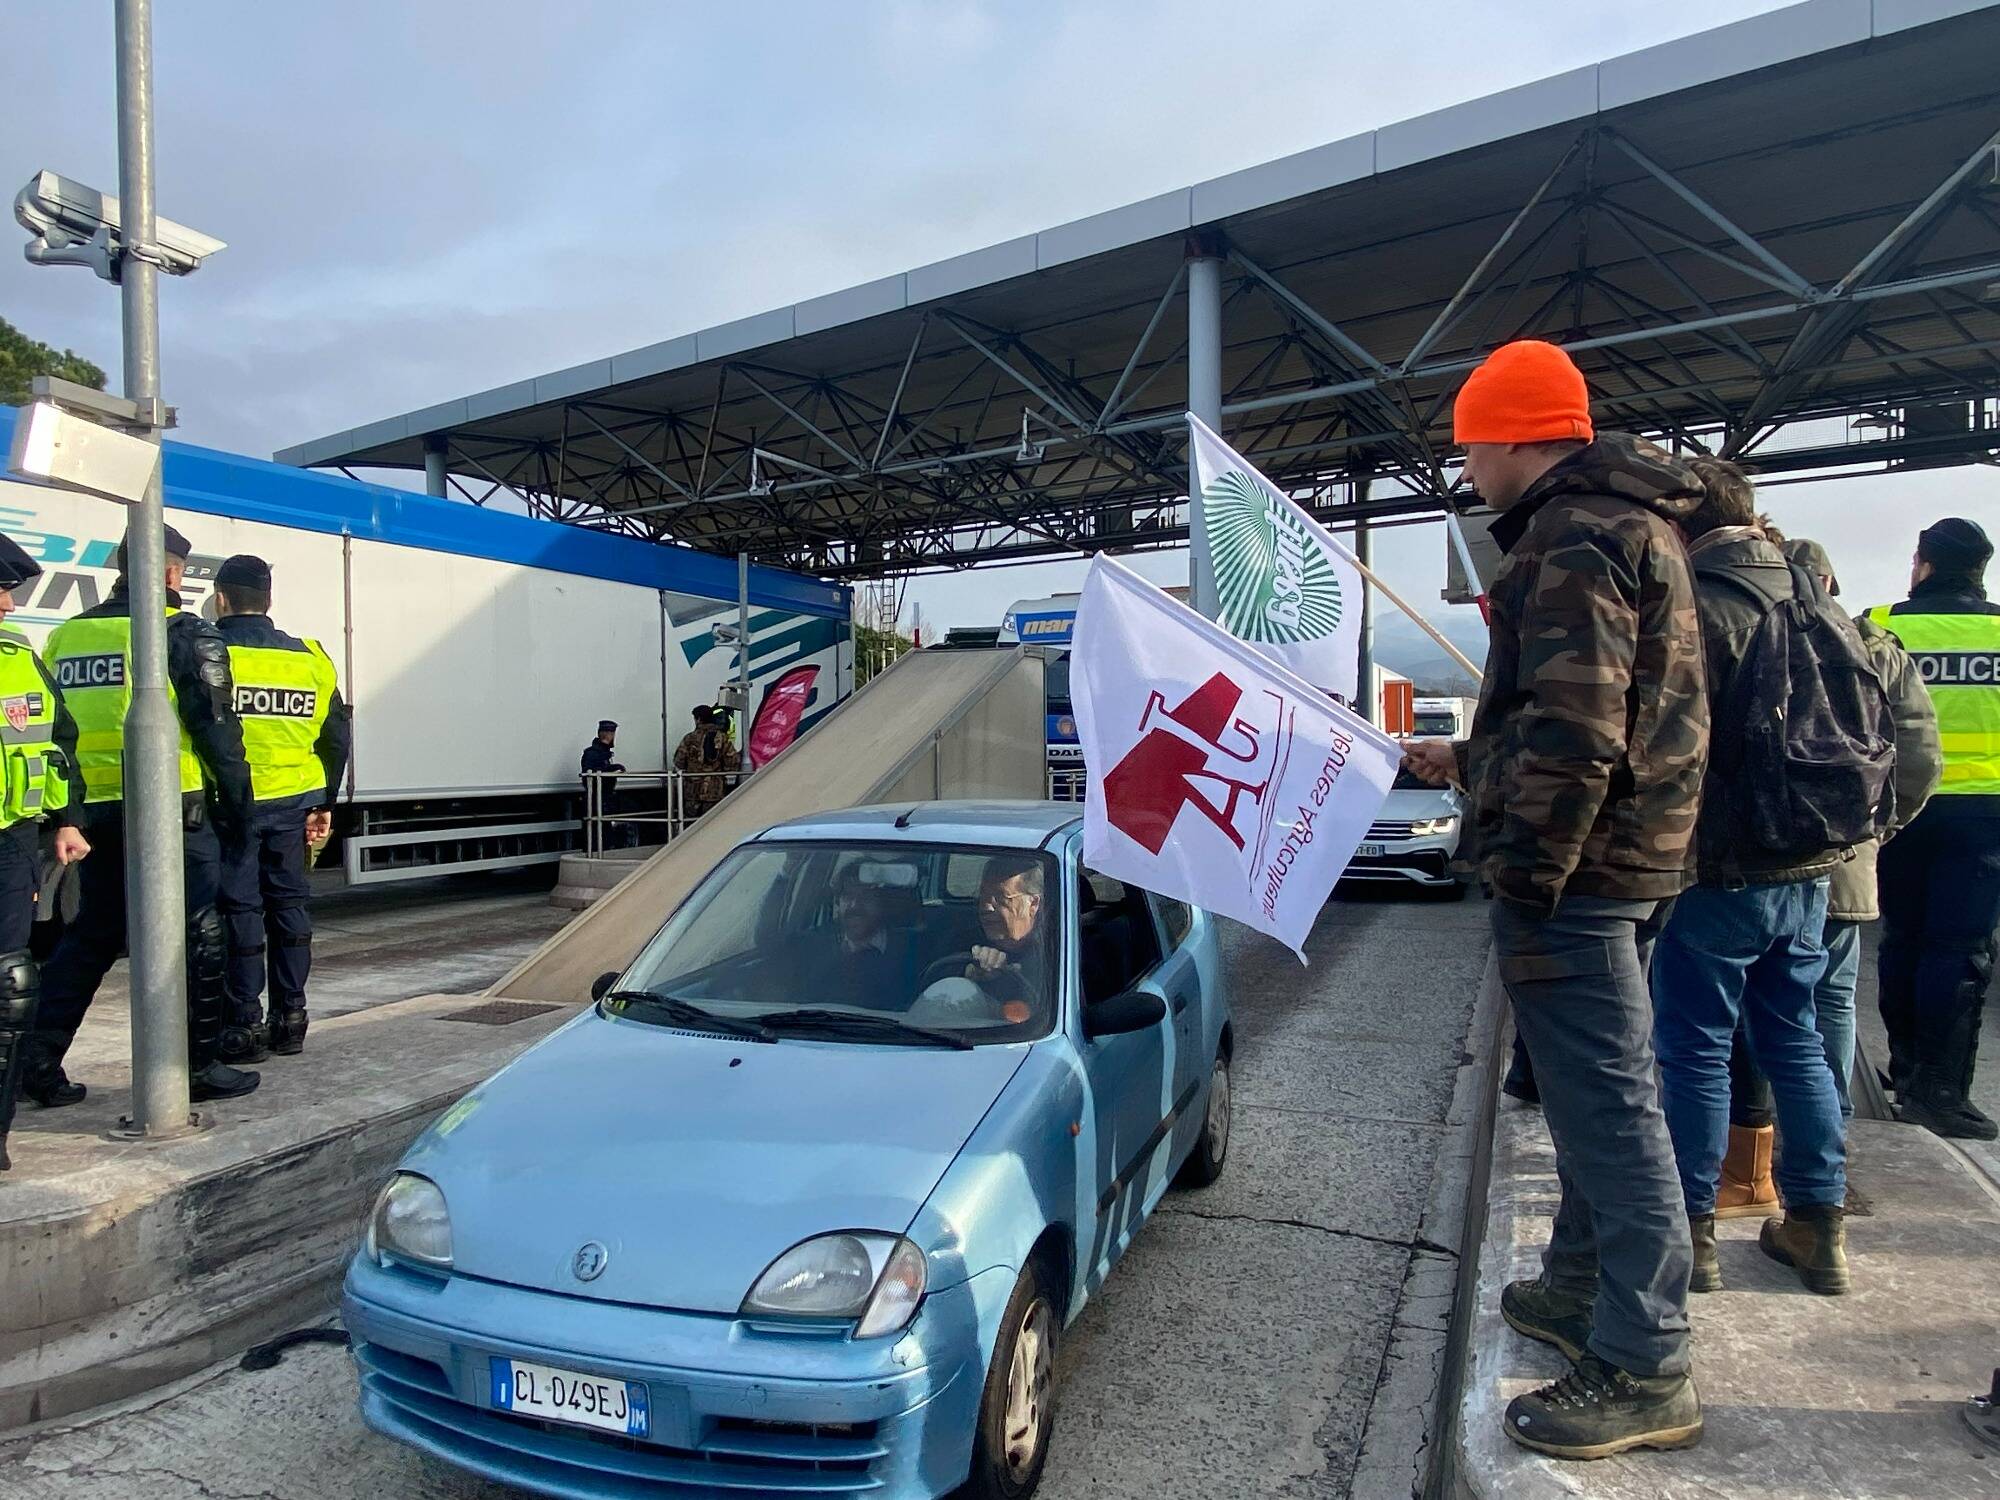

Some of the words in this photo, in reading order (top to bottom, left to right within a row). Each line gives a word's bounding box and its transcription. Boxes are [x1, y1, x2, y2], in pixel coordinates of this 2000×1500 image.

[57, 658, 123, 685] OLICE
[1918, 656, 2000, 681] OLICE
[237, 690, 316, 715] POLICE
[515, 1370, 543, 1405] CL
[552, 1376, 627, 1419] 049EJ
